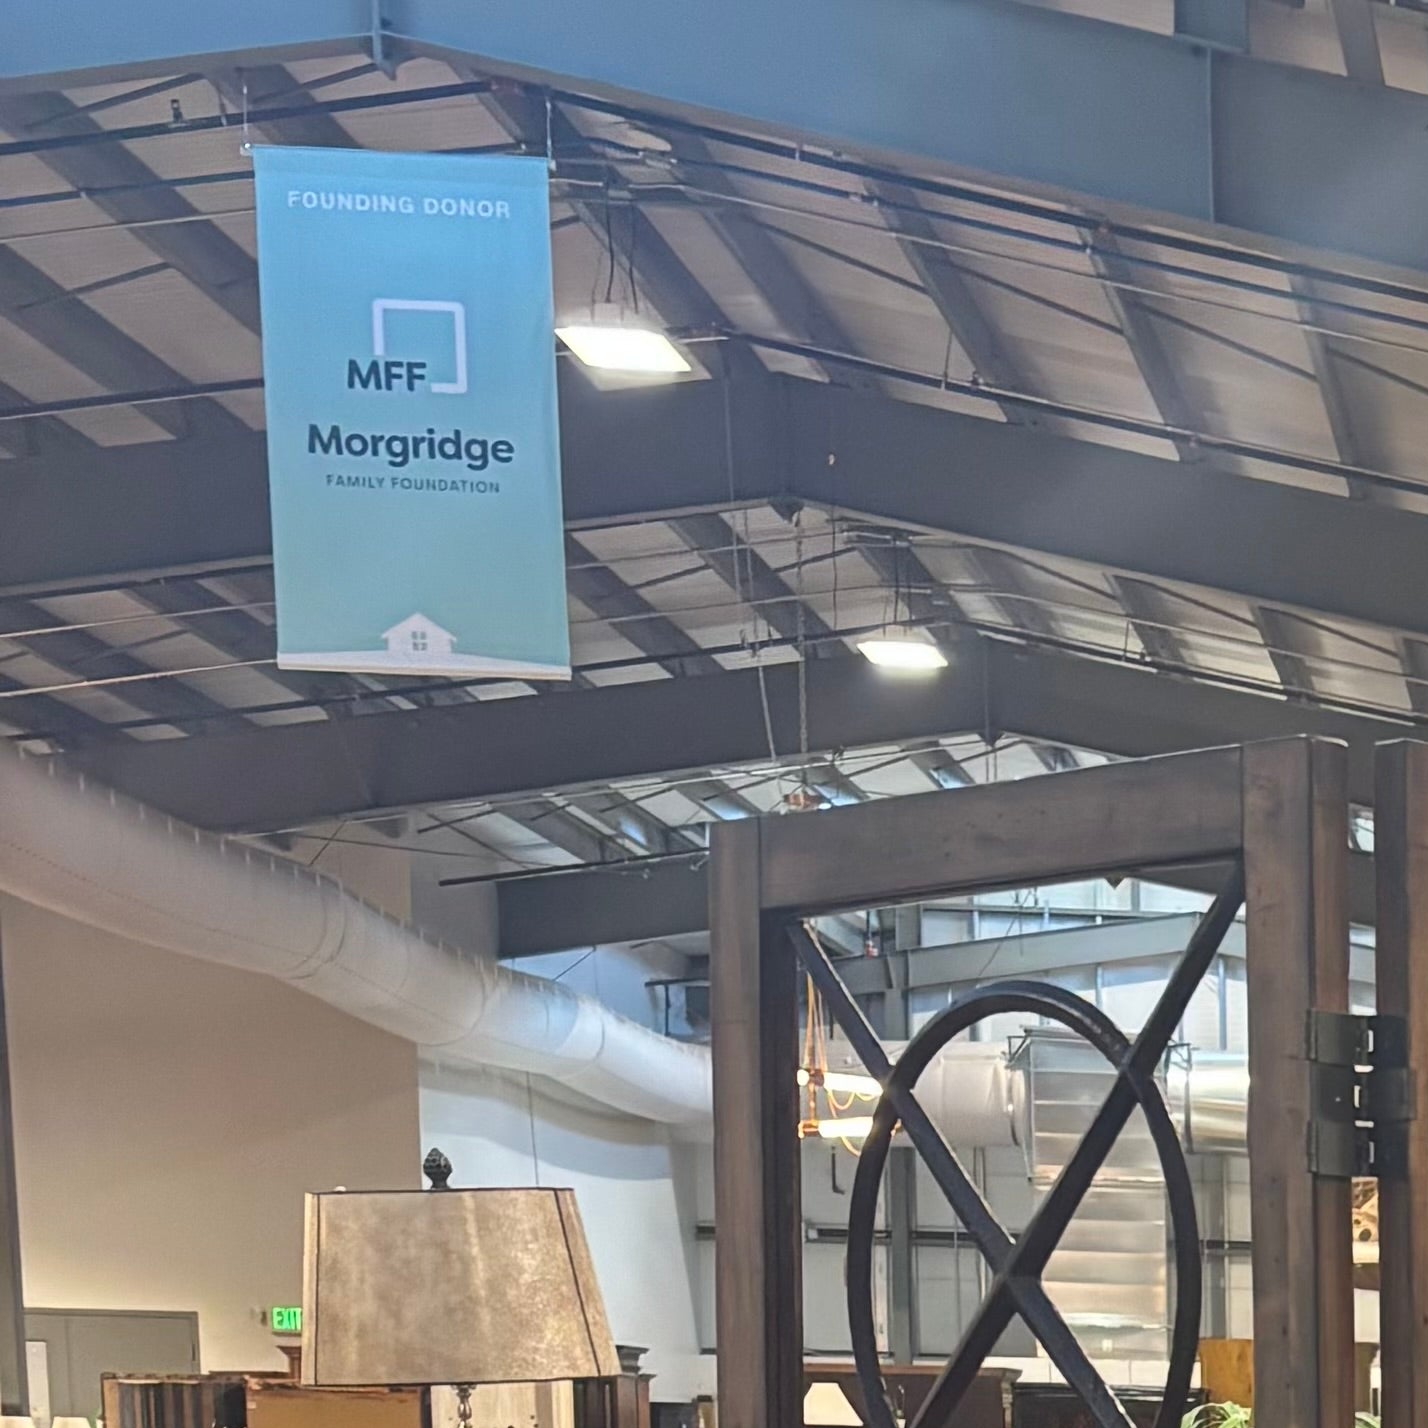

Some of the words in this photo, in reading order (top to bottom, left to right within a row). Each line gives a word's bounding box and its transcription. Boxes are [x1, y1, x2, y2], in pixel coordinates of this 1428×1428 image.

[287, 190, 415, 214] FOUNDING
[423, 197, 510, 219] DONOR
[347, 358, 427, 392] MFF
[307, 423, 515, 471] Morgridge
[326, 474, 385, 489] FAMILY
[391, 476, 500, 494] FOUNDATION
